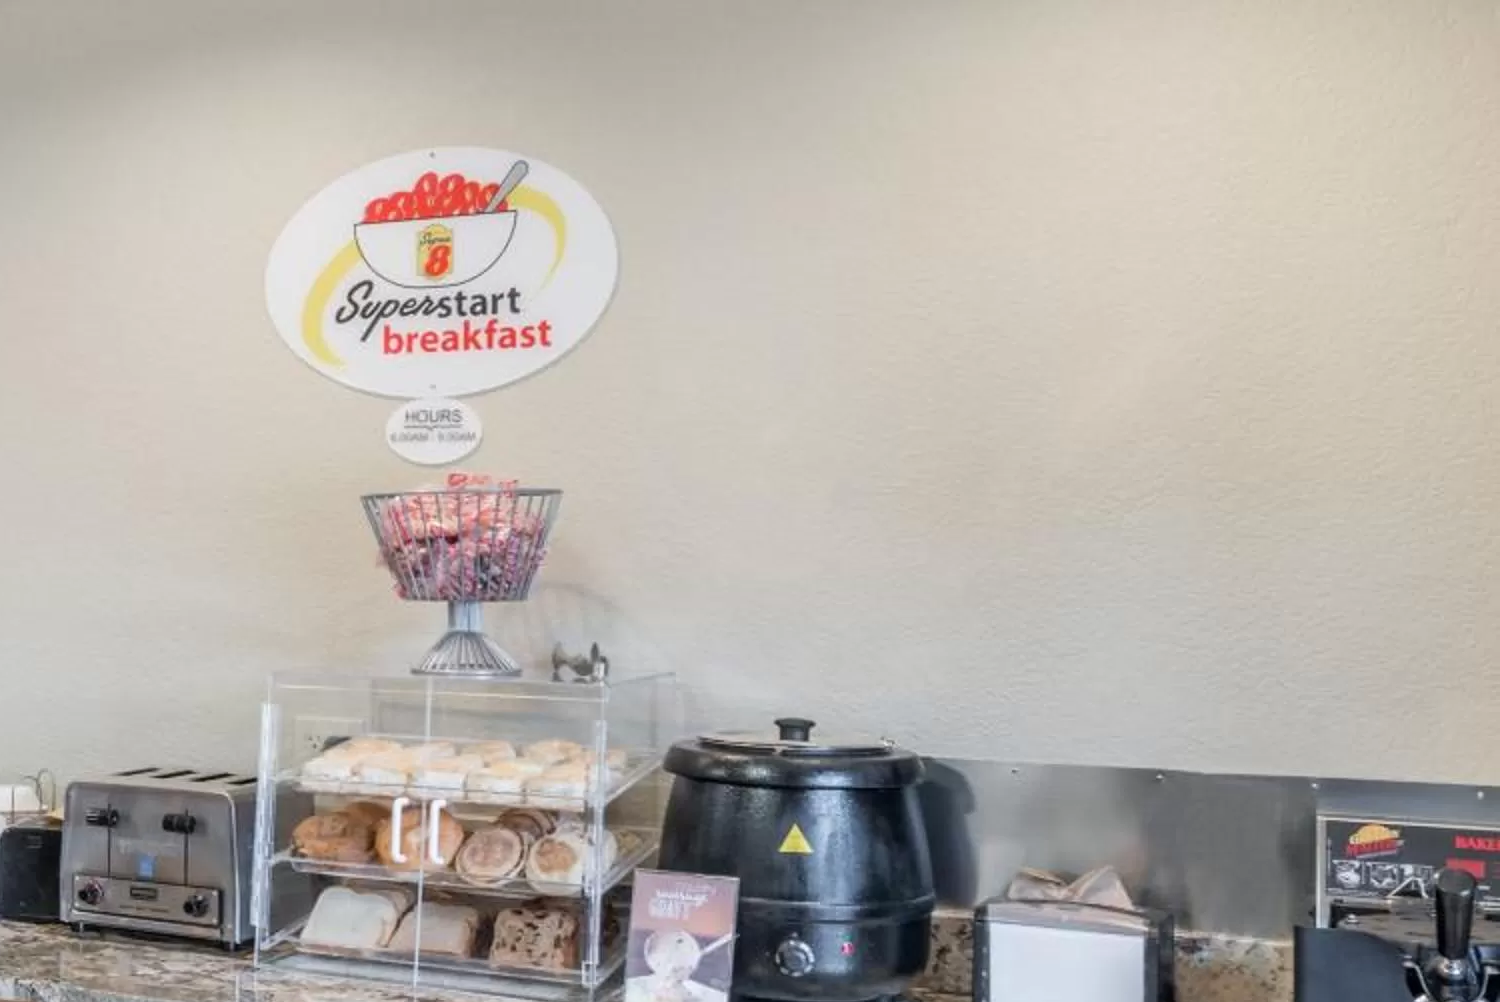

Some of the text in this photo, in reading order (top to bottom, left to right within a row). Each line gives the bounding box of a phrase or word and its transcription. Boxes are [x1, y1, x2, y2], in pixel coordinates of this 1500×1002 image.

[424, 244, 450, 277] 8
[335, 280, 521, 343] Superstart
[382, 319, 553, 355] breakfast
[404, 408, 463, 423] HOURS
